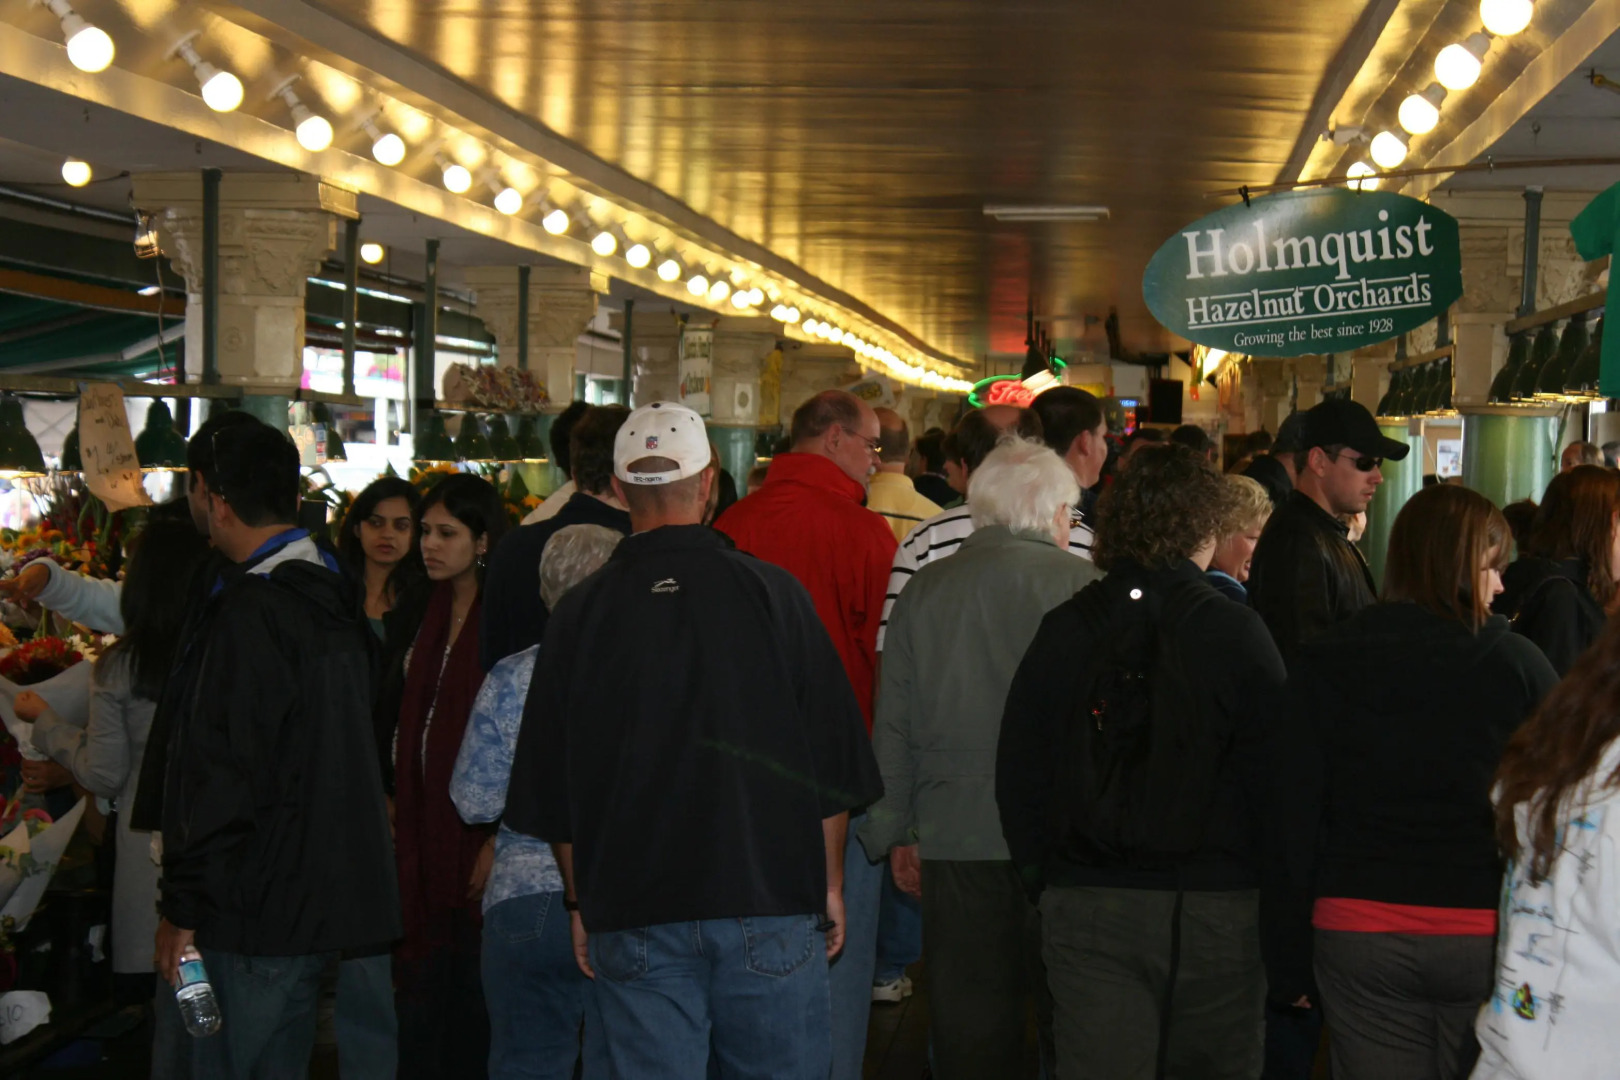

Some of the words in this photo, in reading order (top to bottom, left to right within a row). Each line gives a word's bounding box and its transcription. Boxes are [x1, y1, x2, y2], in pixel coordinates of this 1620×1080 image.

[1182, 209, 1434, 281] Holmquist
[1186, 286, 1305, 324] Hazelnut
[1314, 273, 1432, 312] Orchards
[1234, 328, 1285, 348] Growing
[1288, 325, 1307, 341] the
[1311, 323, 1333, 339] best
[1337, 321, 1365, 337] since
[1368, 318, 1394, 333] 1928
